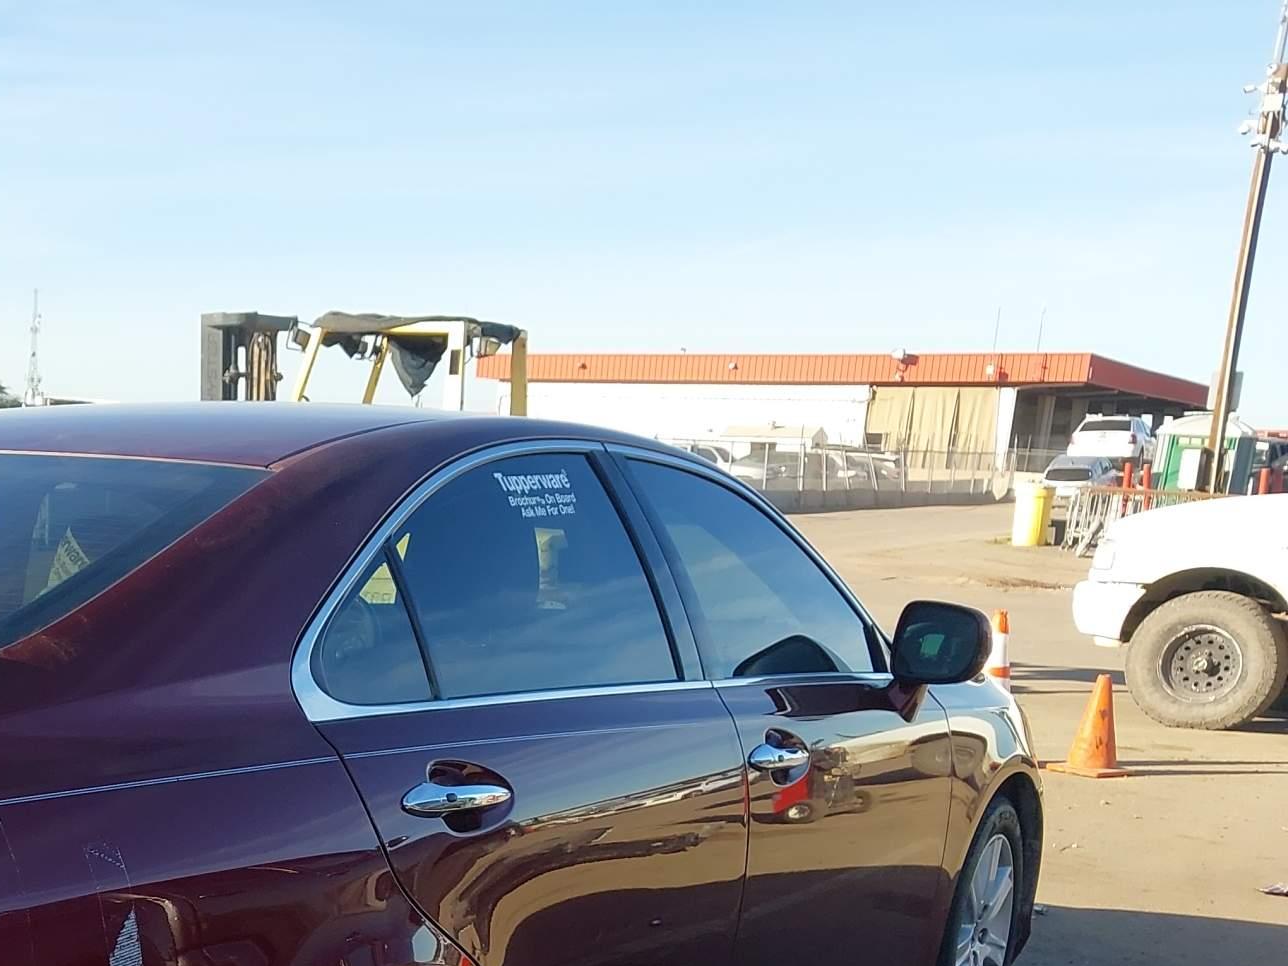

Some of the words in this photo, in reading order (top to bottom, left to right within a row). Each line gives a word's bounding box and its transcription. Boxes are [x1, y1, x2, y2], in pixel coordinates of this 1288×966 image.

[493, 471, 570, 494] Tupperware
[545, 494, 556, 504] On
[555, 492, 576, 503] Board
[522, 507, 536, 518] Ask
[535, 506, 547, 516] Me
[547, 505, 559, 516] For
